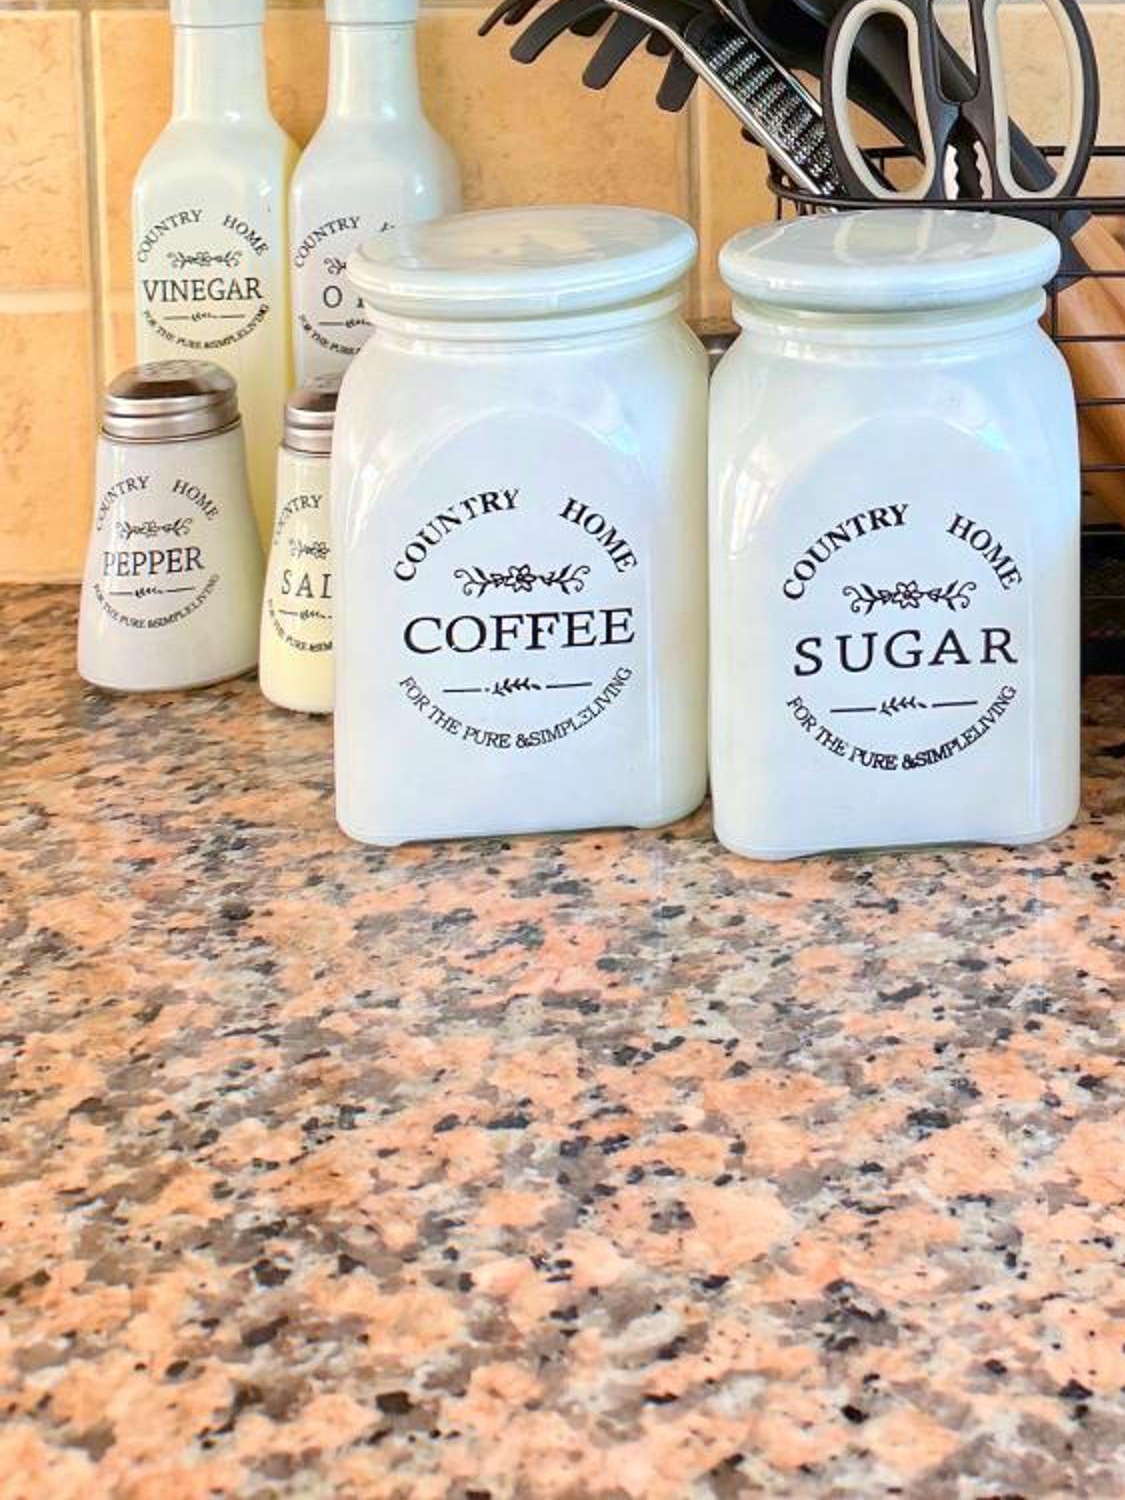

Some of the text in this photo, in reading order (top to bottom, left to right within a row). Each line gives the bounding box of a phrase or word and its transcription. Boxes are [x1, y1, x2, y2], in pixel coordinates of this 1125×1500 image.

[137, 208, 270, 264] COUNTRY HOME
[294, 215, 361, 269] COUNTRY
[142, 277, 263, 303] VINEGAR
[172, 478, 220, 521] HOME
[103, 546, 205, 577] PEPPER
[393, 488, 638, 582] COUNTRY HOME
[783, 503, 1023, 601] COUNTRY HOME
[403, 607, 636, 655] COFFEE
[794, 627, 1019, 677] SUGAR
[399, 675, 431, 712] FOR
[427, 705, 463, 736] THE
[462, 725, 511, 749] PURE
[786, 695, 818, 733] FOR
[814, 726, 847, 758] THE
[848, 748, 898, 771] PURE
